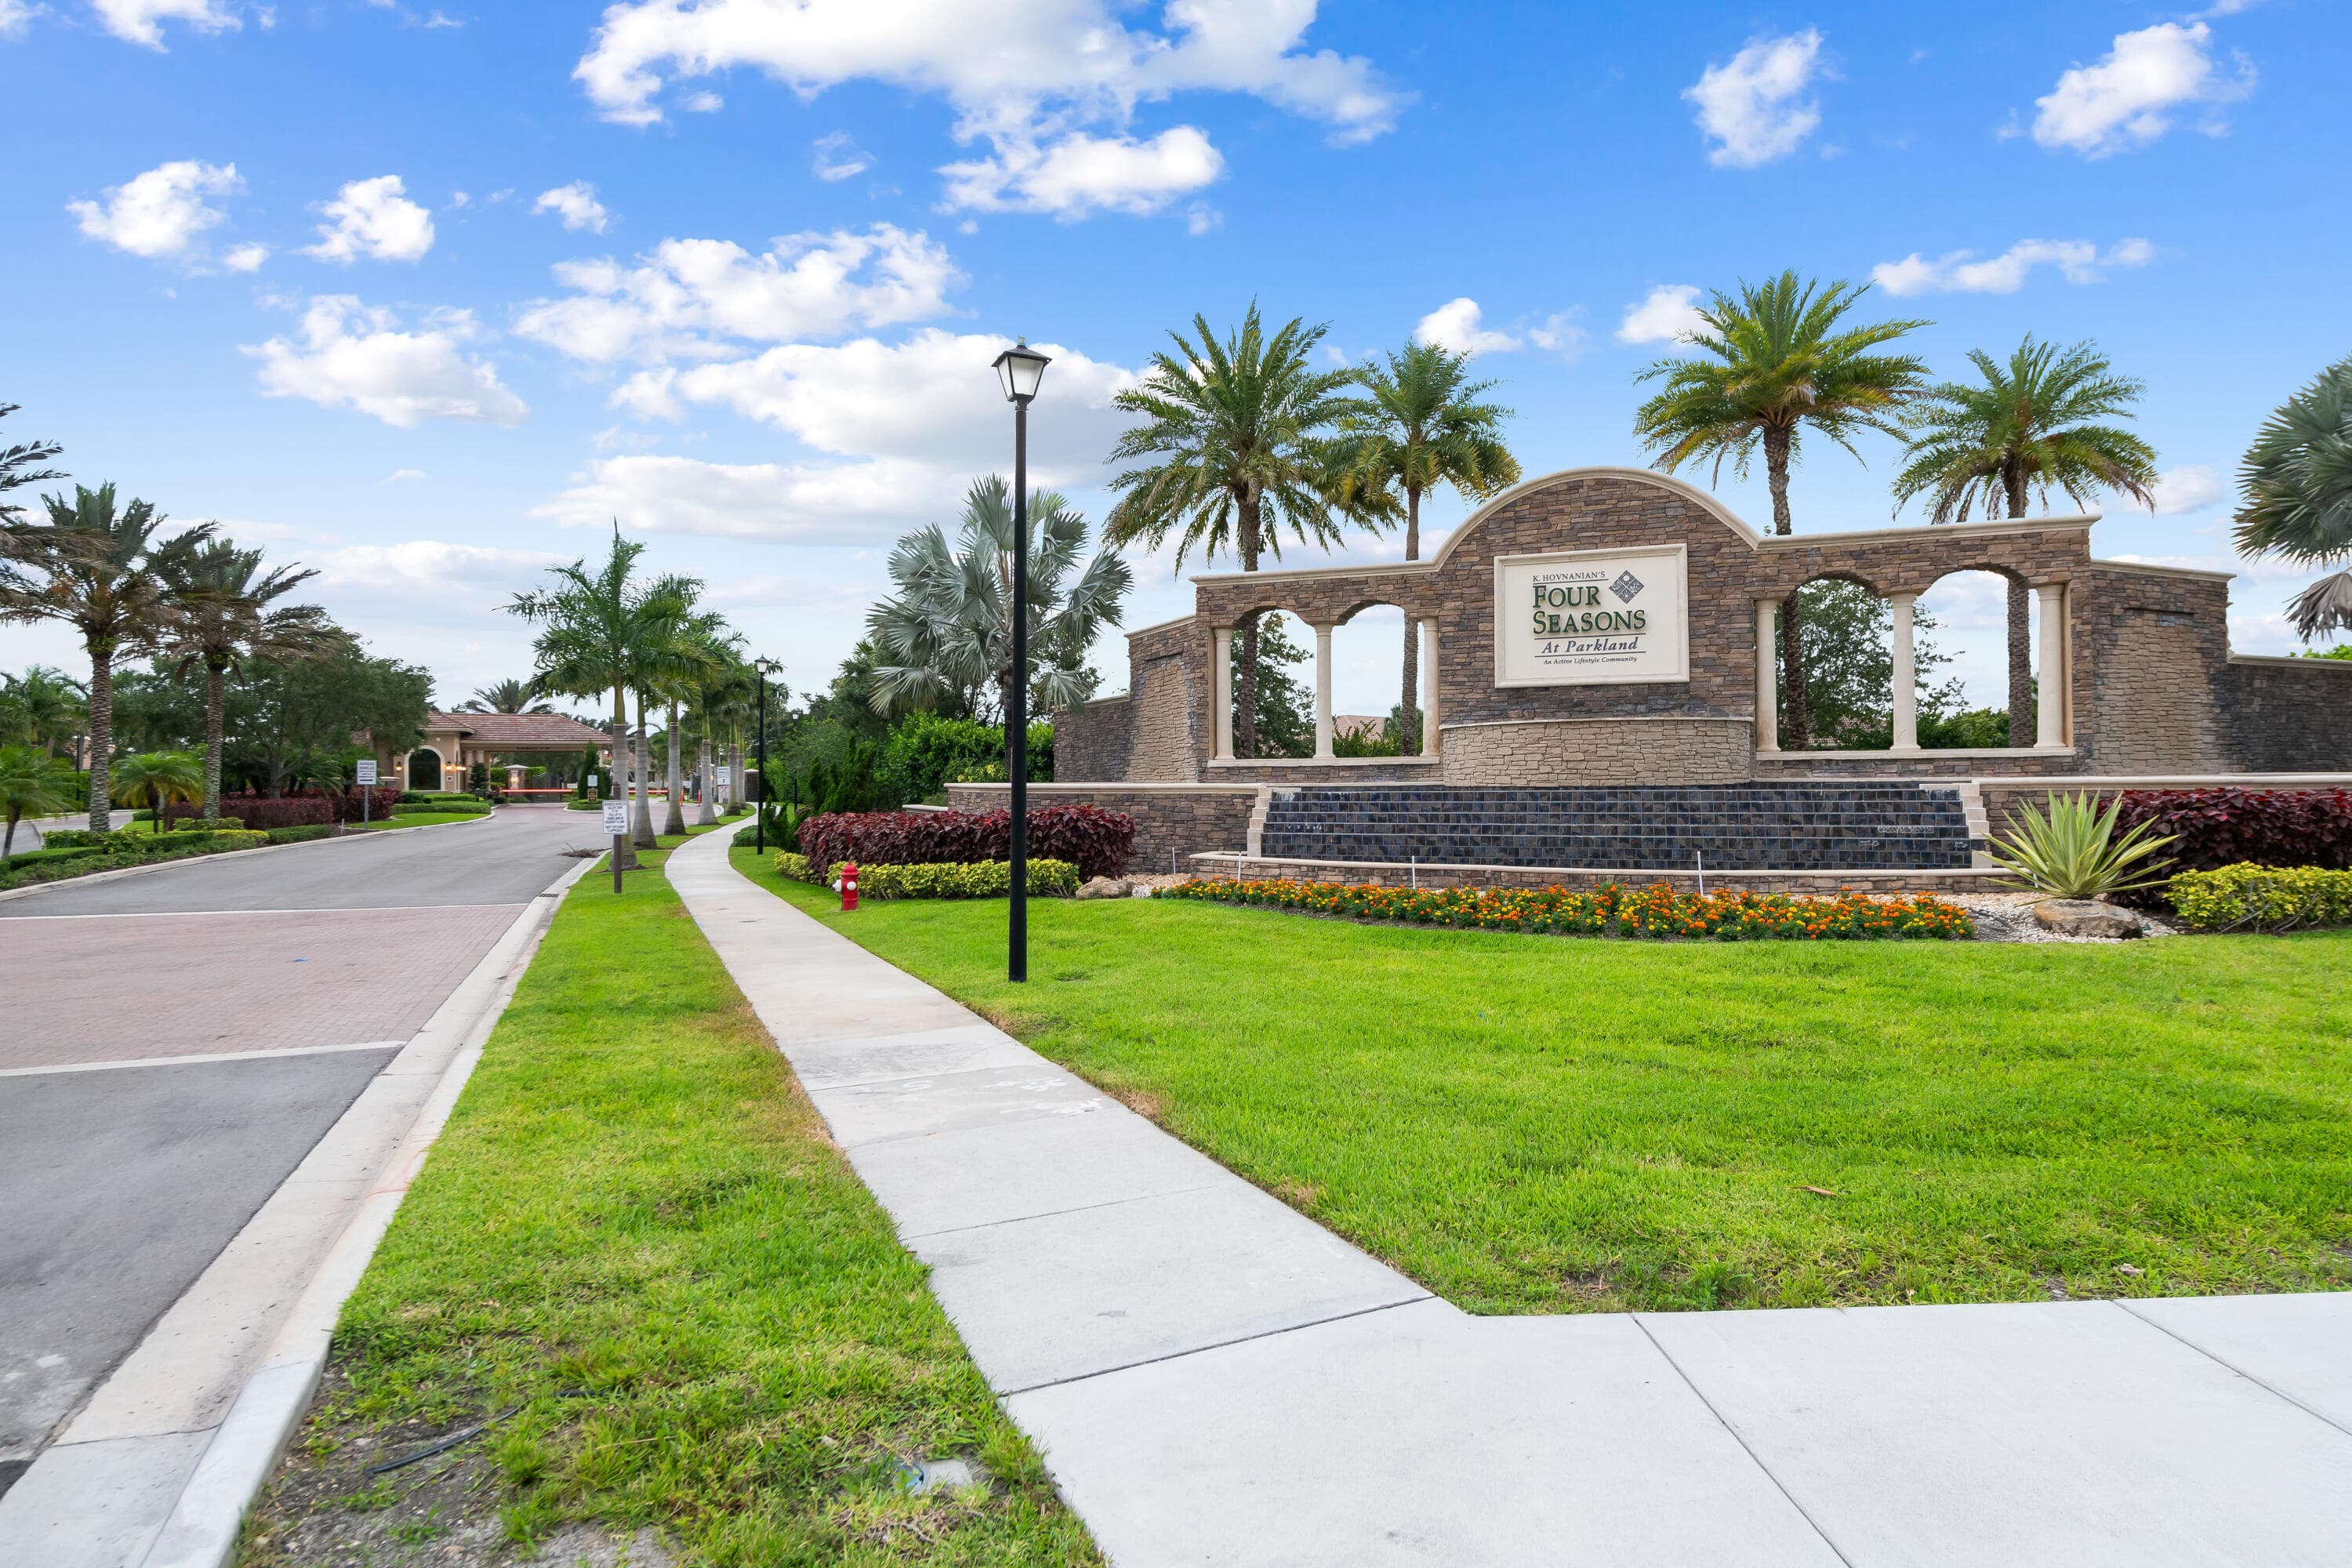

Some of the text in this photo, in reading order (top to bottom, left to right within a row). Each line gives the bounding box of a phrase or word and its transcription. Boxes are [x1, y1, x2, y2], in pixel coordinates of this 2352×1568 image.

[1543, 572, 1606, 580] HOVNANIAN'S
[1533, 586, 1601, 608] FOUR
[1533, 610, 1646, 635] SEASONS
[1542, 637, 1639, 653] At Parkland
